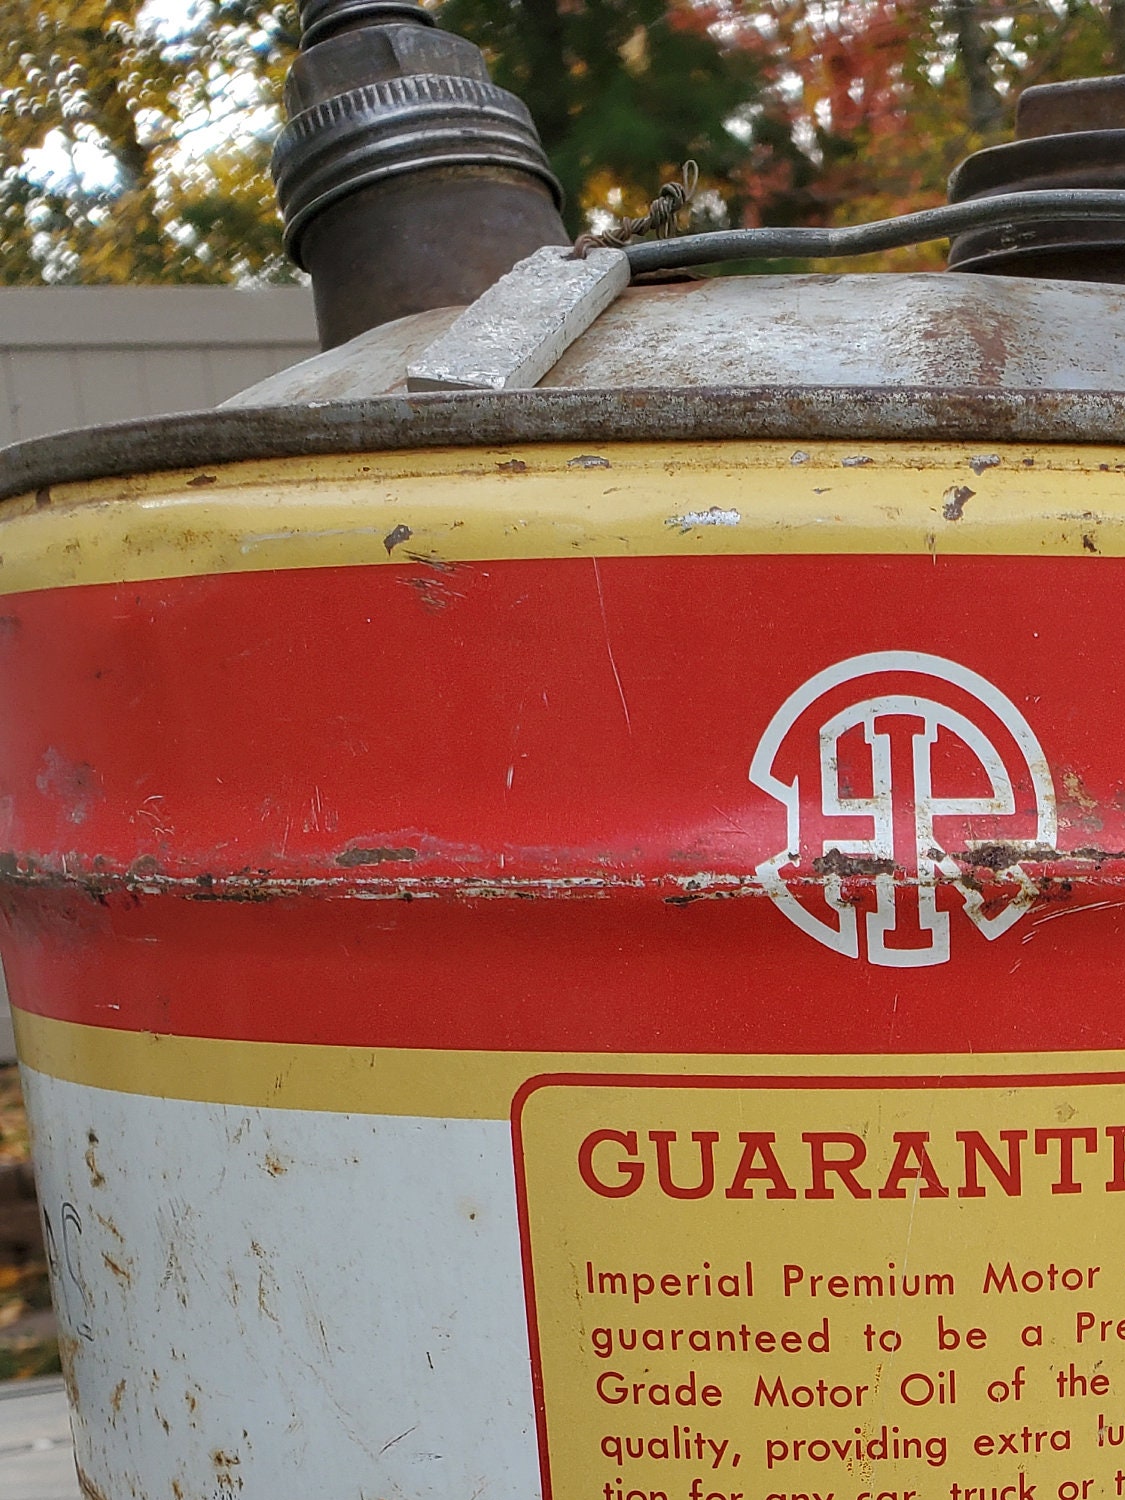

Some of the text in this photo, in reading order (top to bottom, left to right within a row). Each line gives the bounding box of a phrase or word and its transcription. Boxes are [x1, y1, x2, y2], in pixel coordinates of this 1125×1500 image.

[586, 1261, 753, 1304] Imperial
[783, 1262, 954, 1298] Premium
[982, 1261, 1101, 1294] Motor
[591, 1317, 830, 1359] guaranteed
[863, 1323, 902, 1353] to
[937, 1315, 987, 1351] be
[1021, 1325, 1043, 1347] a
[596, 1370, 723, 1407] Grade
[753, 1374, 869, 1408] Motor
[900, 1369, 956, 1407] Oil
[987, 1365, 1026, 1403] of
[1056, 1362, 1110, 1398] the
[600, 1425, 741, 1469] quality,
[766, 1425, 947, 1470] providing
[973, 1426, 1071, 1457] extra
